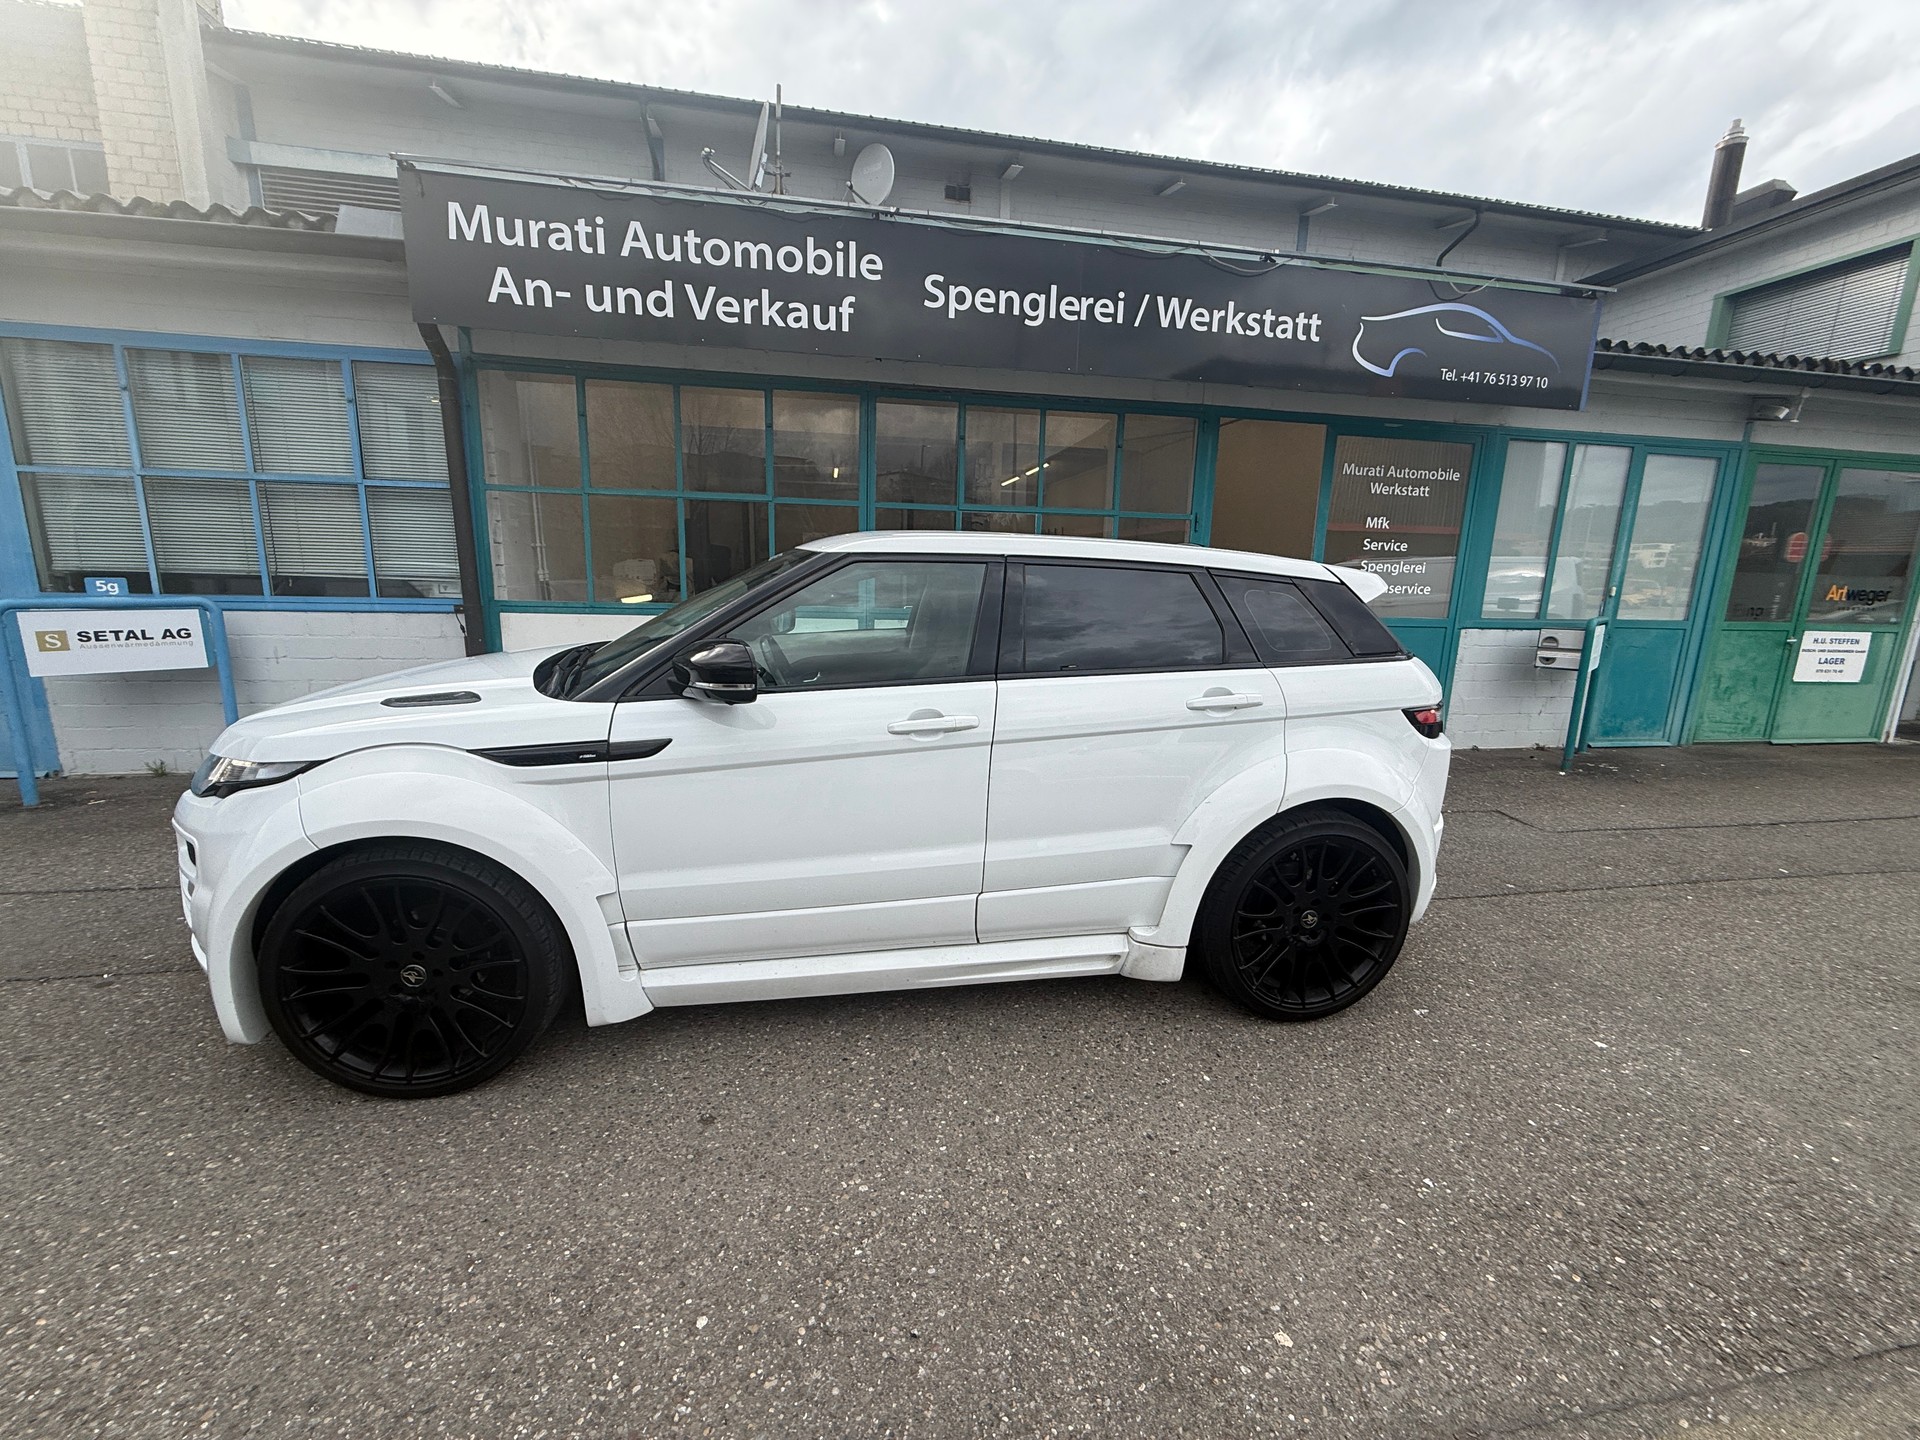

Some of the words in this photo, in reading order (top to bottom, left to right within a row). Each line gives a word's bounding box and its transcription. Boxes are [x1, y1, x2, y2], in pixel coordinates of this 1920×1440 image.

[447, 201, 606, 255] Murati
[620, 220, 884, 281] Automobile
[487, 266, 571, 308] An-
[584, 279, 674, 319] und
[684, 283, 856, 333] Verkauf
[922, 273, 1126, 327] Spenglerei
[1156, 294, 1323, 343] Werkstatt
[1440, 368, 1458, 382] Tel.
[1460, 371, 1480, 383] +41
[1483, 372, 1497, 385] 76
[1497, 373, 1518, 386] 513
[1519, 375, 1534, 388] 97
[1536, 376, 1548, 389] 10
[1342, 462, 1385, 477] Murati
[1386, 465, 1461, 481] Automobile
[1369, 482, 1430, 497] Werkstatt
[1365, 516, 1390, 530] Mfk
[1362, 538, 1408, 552] Service
[1360, 560, 1427, 576] Spenglerei
[95, 580, 120, 595] 5g
[1825, 584, 1891, 606] Artweger
[76, 629, 154, 643] SETAL
[161, 628, 192, 640] AG
[1828, 637, 1860, 645] STEFFEN
[1818, 657, 1846, 665] LAGER
